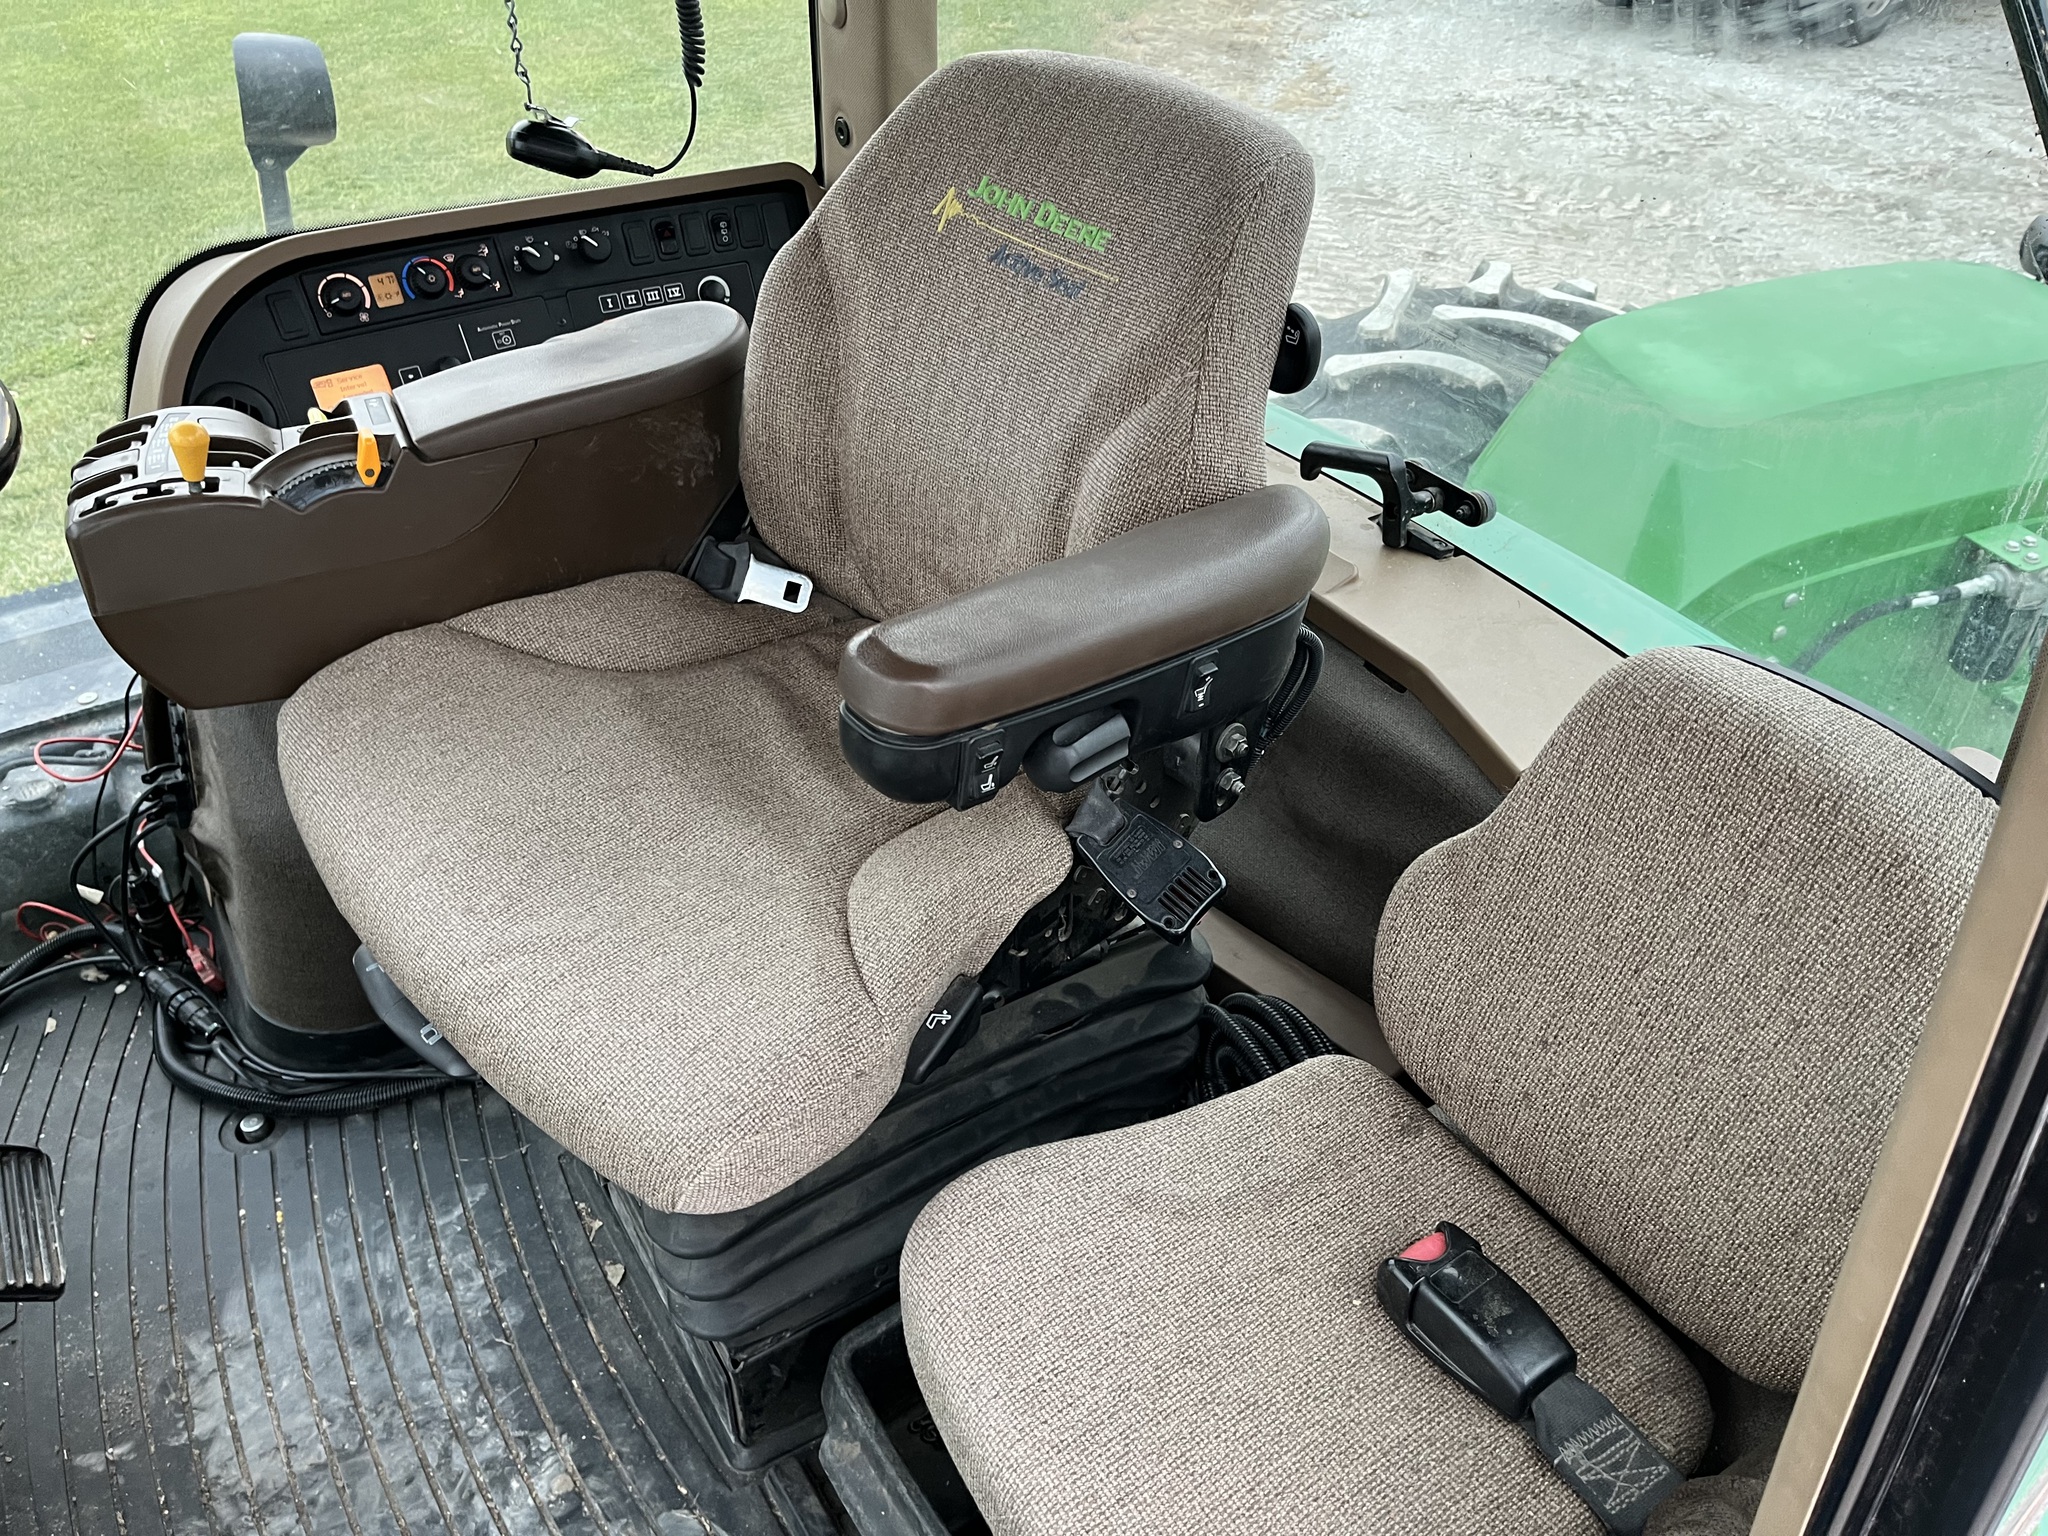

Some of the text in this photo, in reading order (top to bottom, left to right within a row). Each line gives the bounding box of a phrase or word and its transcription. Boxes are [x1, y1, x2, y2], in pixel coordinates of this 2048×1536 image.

[966, 175, 1112, 252] JOHN DEERE
[626, 294, 637, 305] II
[646, 290, 660, 301] III
[667, 286, 682, 298] IV
[336, 374, 363, 384] Service
